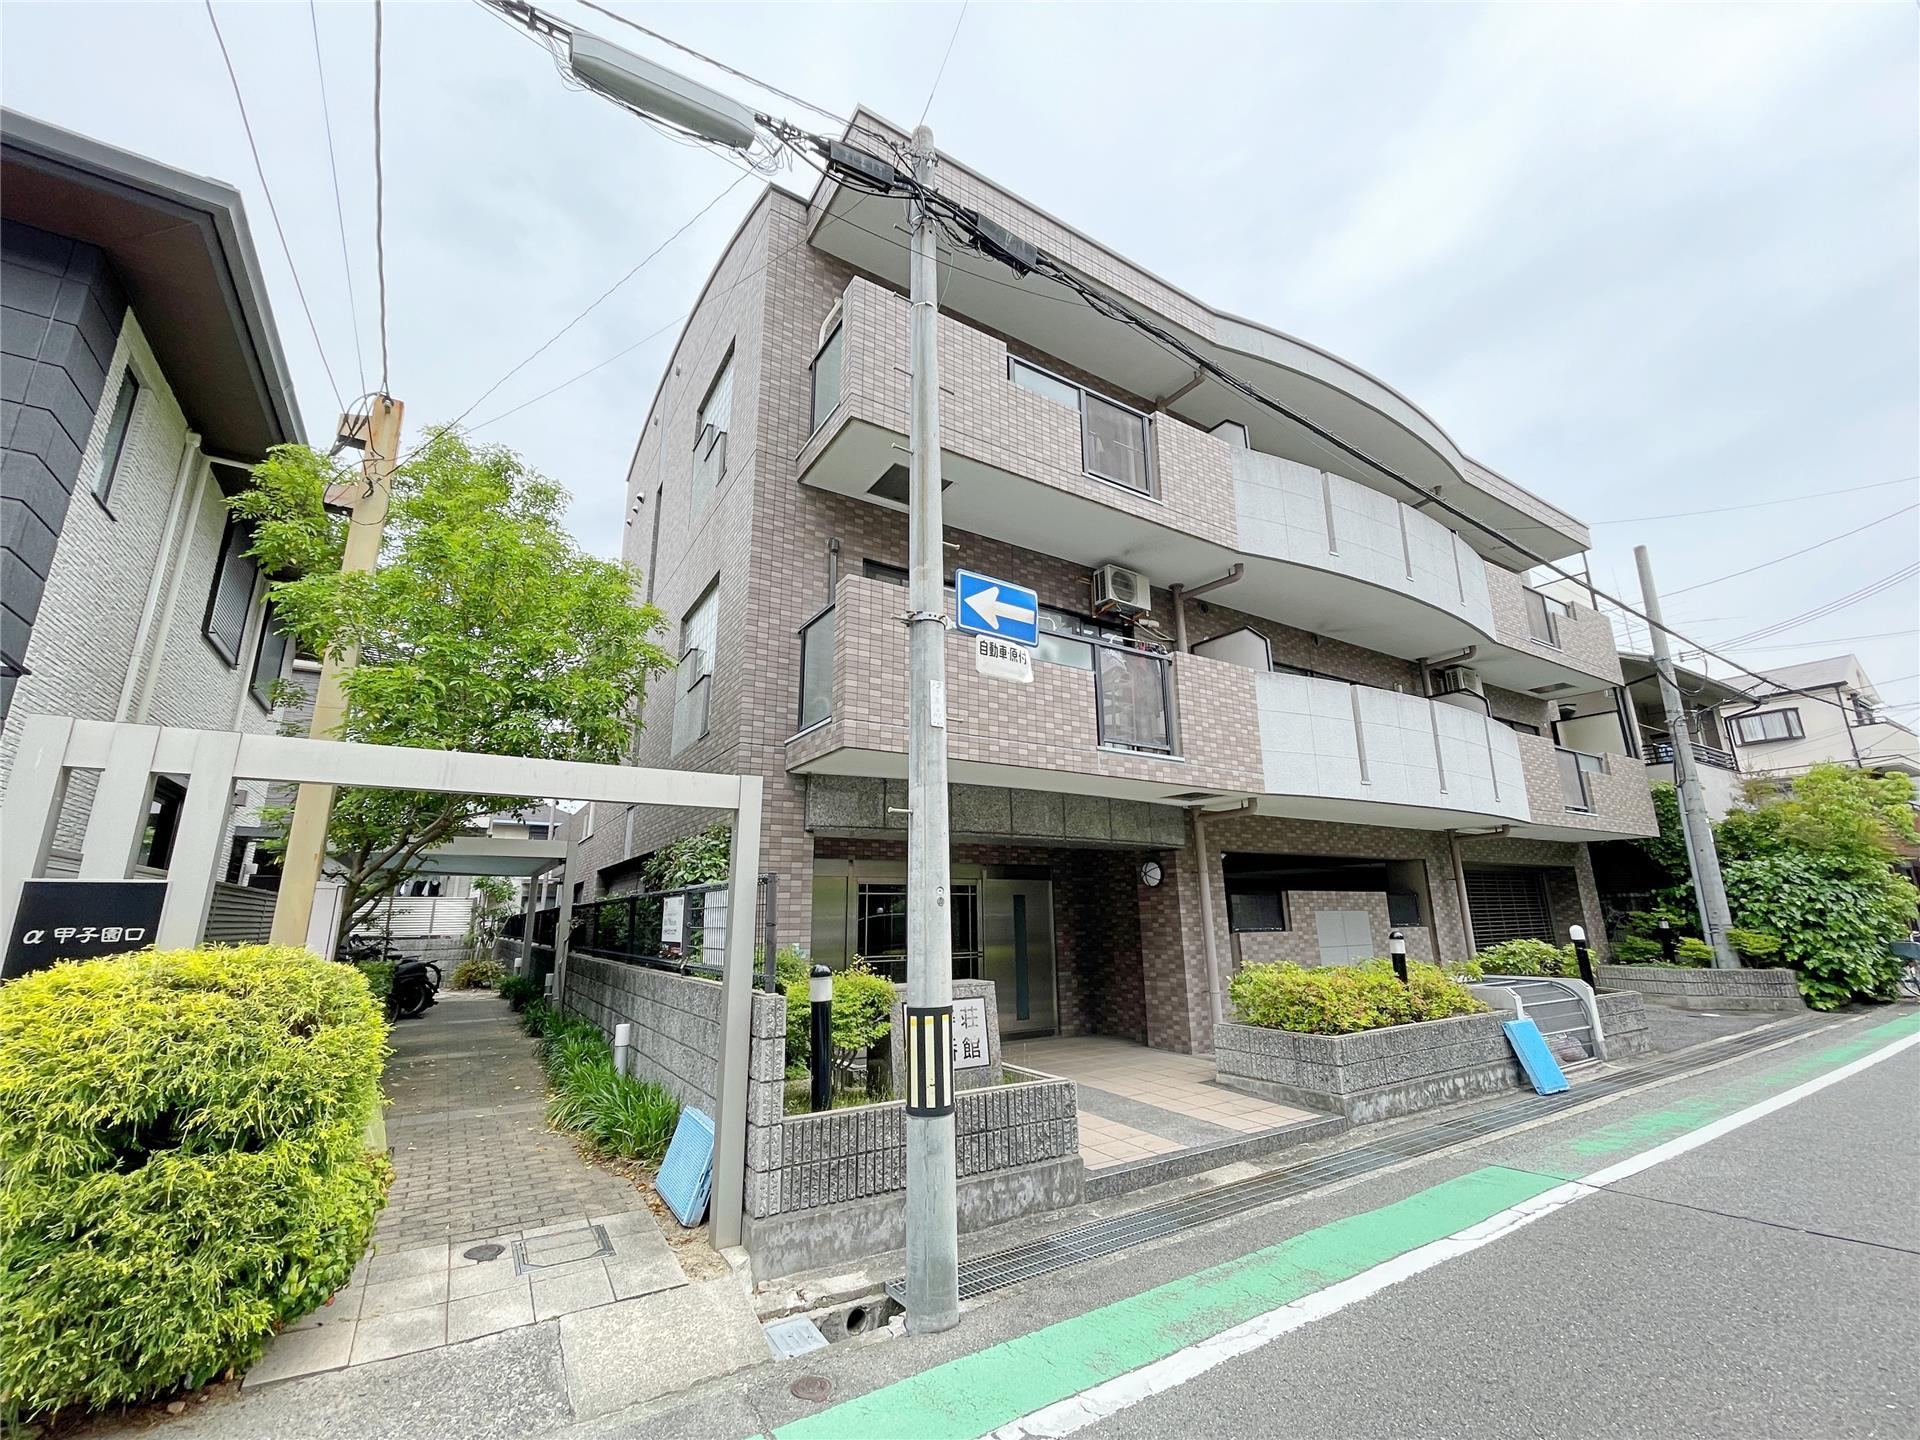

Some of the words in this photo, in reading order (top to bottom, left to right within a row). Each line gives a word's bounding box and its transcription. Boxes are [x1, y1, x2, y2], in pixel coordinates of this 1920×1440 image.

[53, 927, 146, 944] 甲子園口
[953, 1006, 978, 1029] 荘
[953, 1036, 980, 1061] 館
